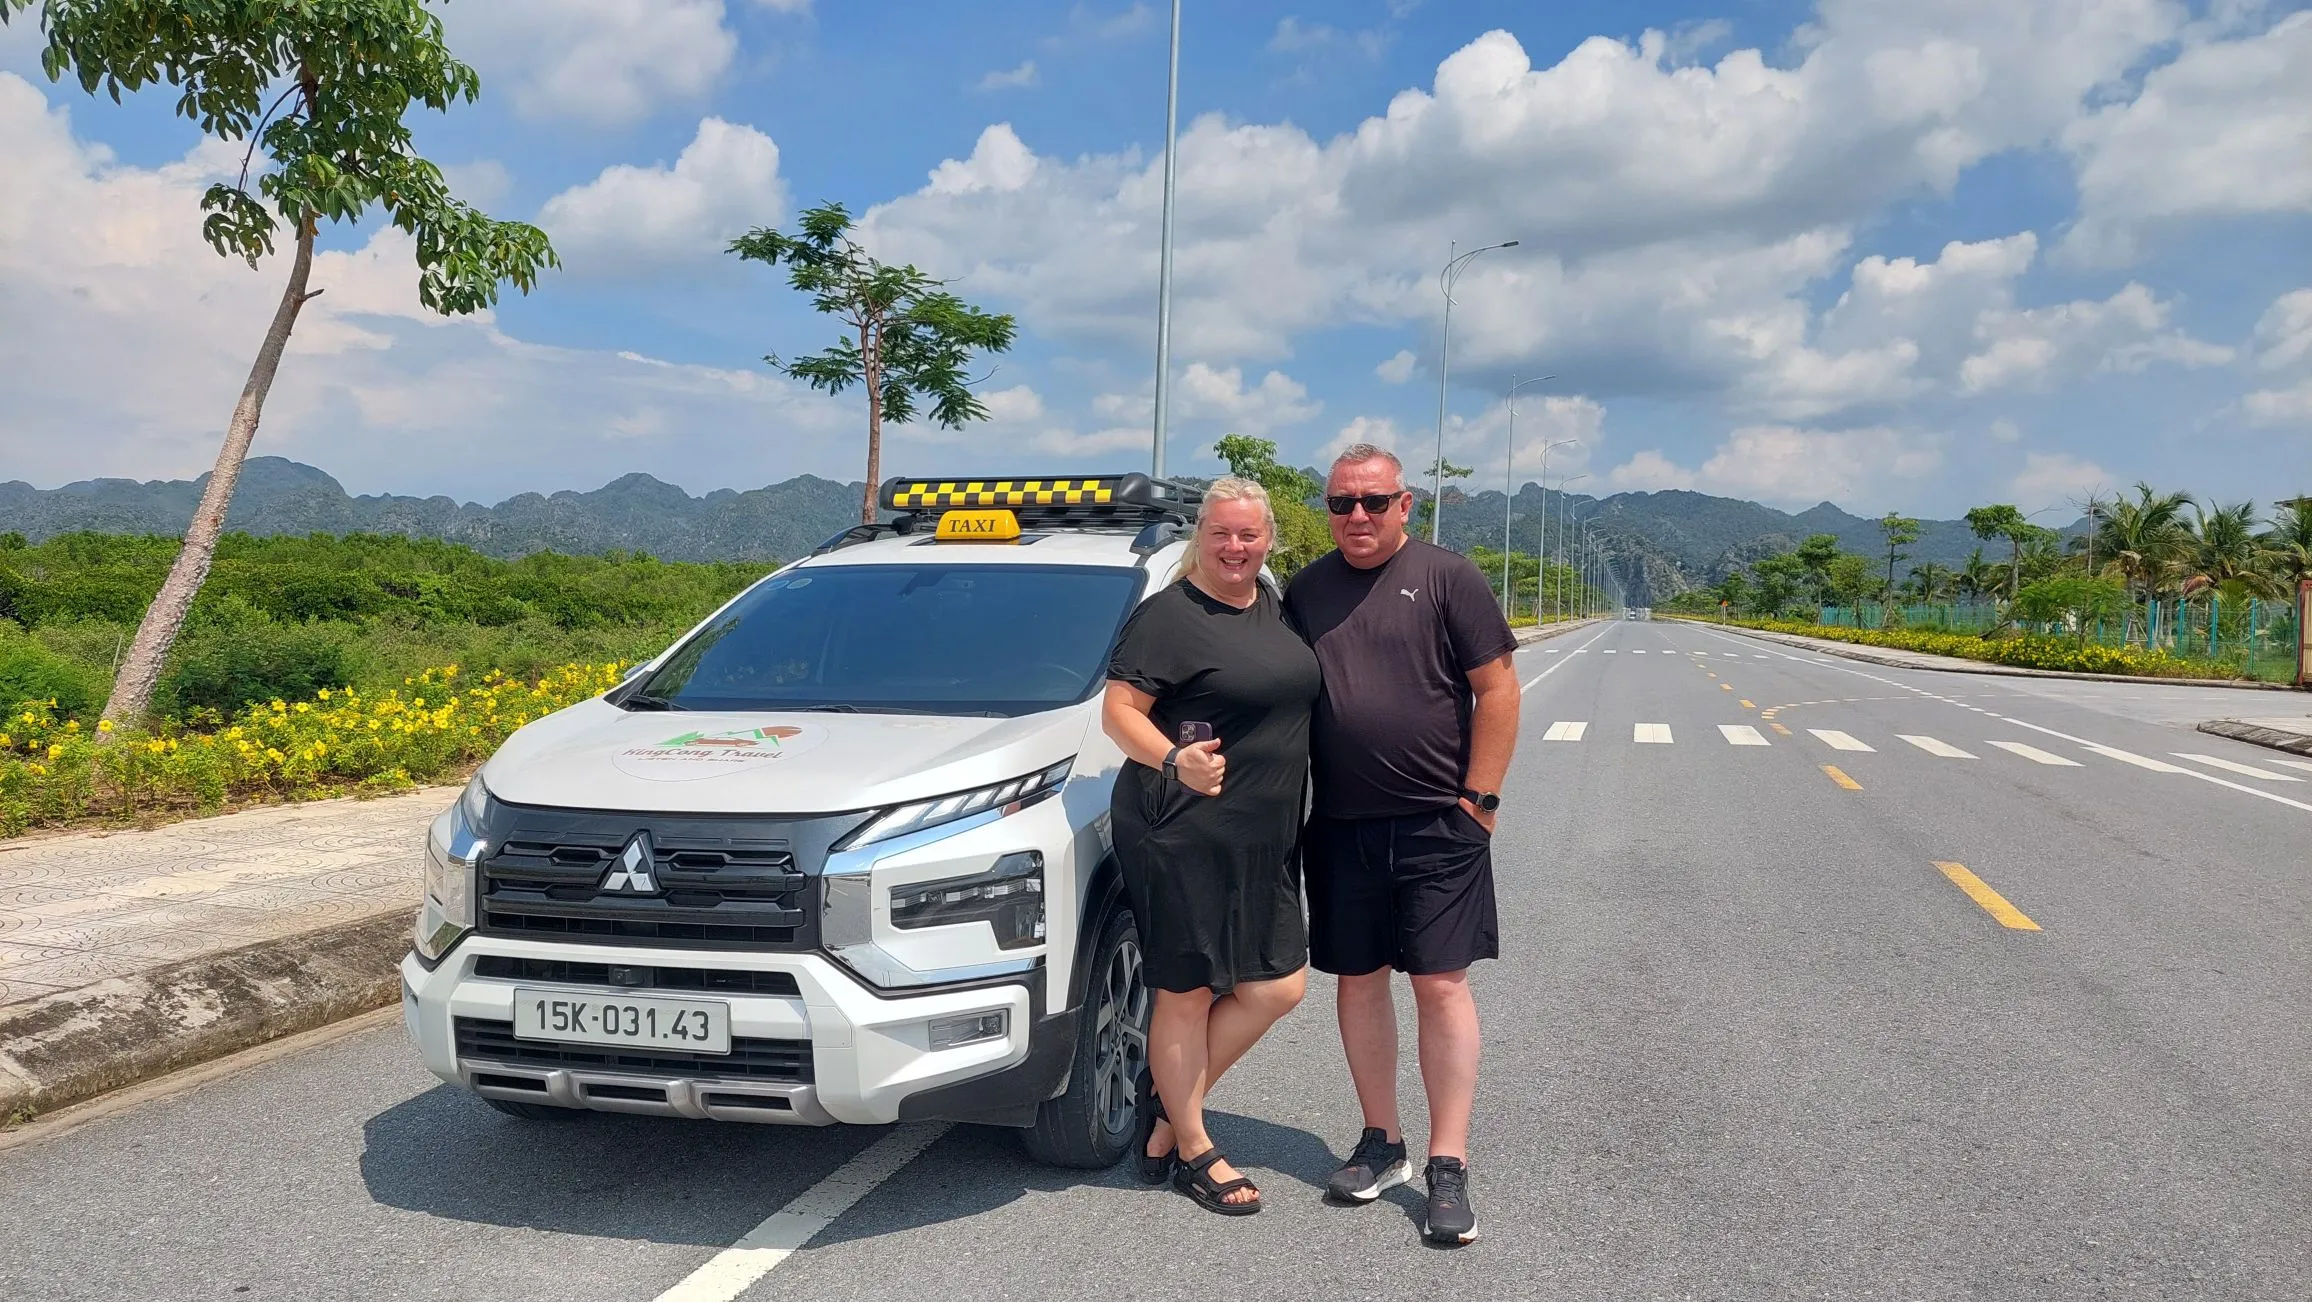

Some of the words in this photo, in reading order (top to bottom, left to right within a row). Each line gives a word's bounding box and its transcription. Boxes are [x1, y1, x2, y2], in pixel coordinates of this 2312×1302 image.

[948, 519, 996, 533] TAXI
[719, 749, 784, 759] Travel
[536, 999, 709, 1041] 15K-031.43
